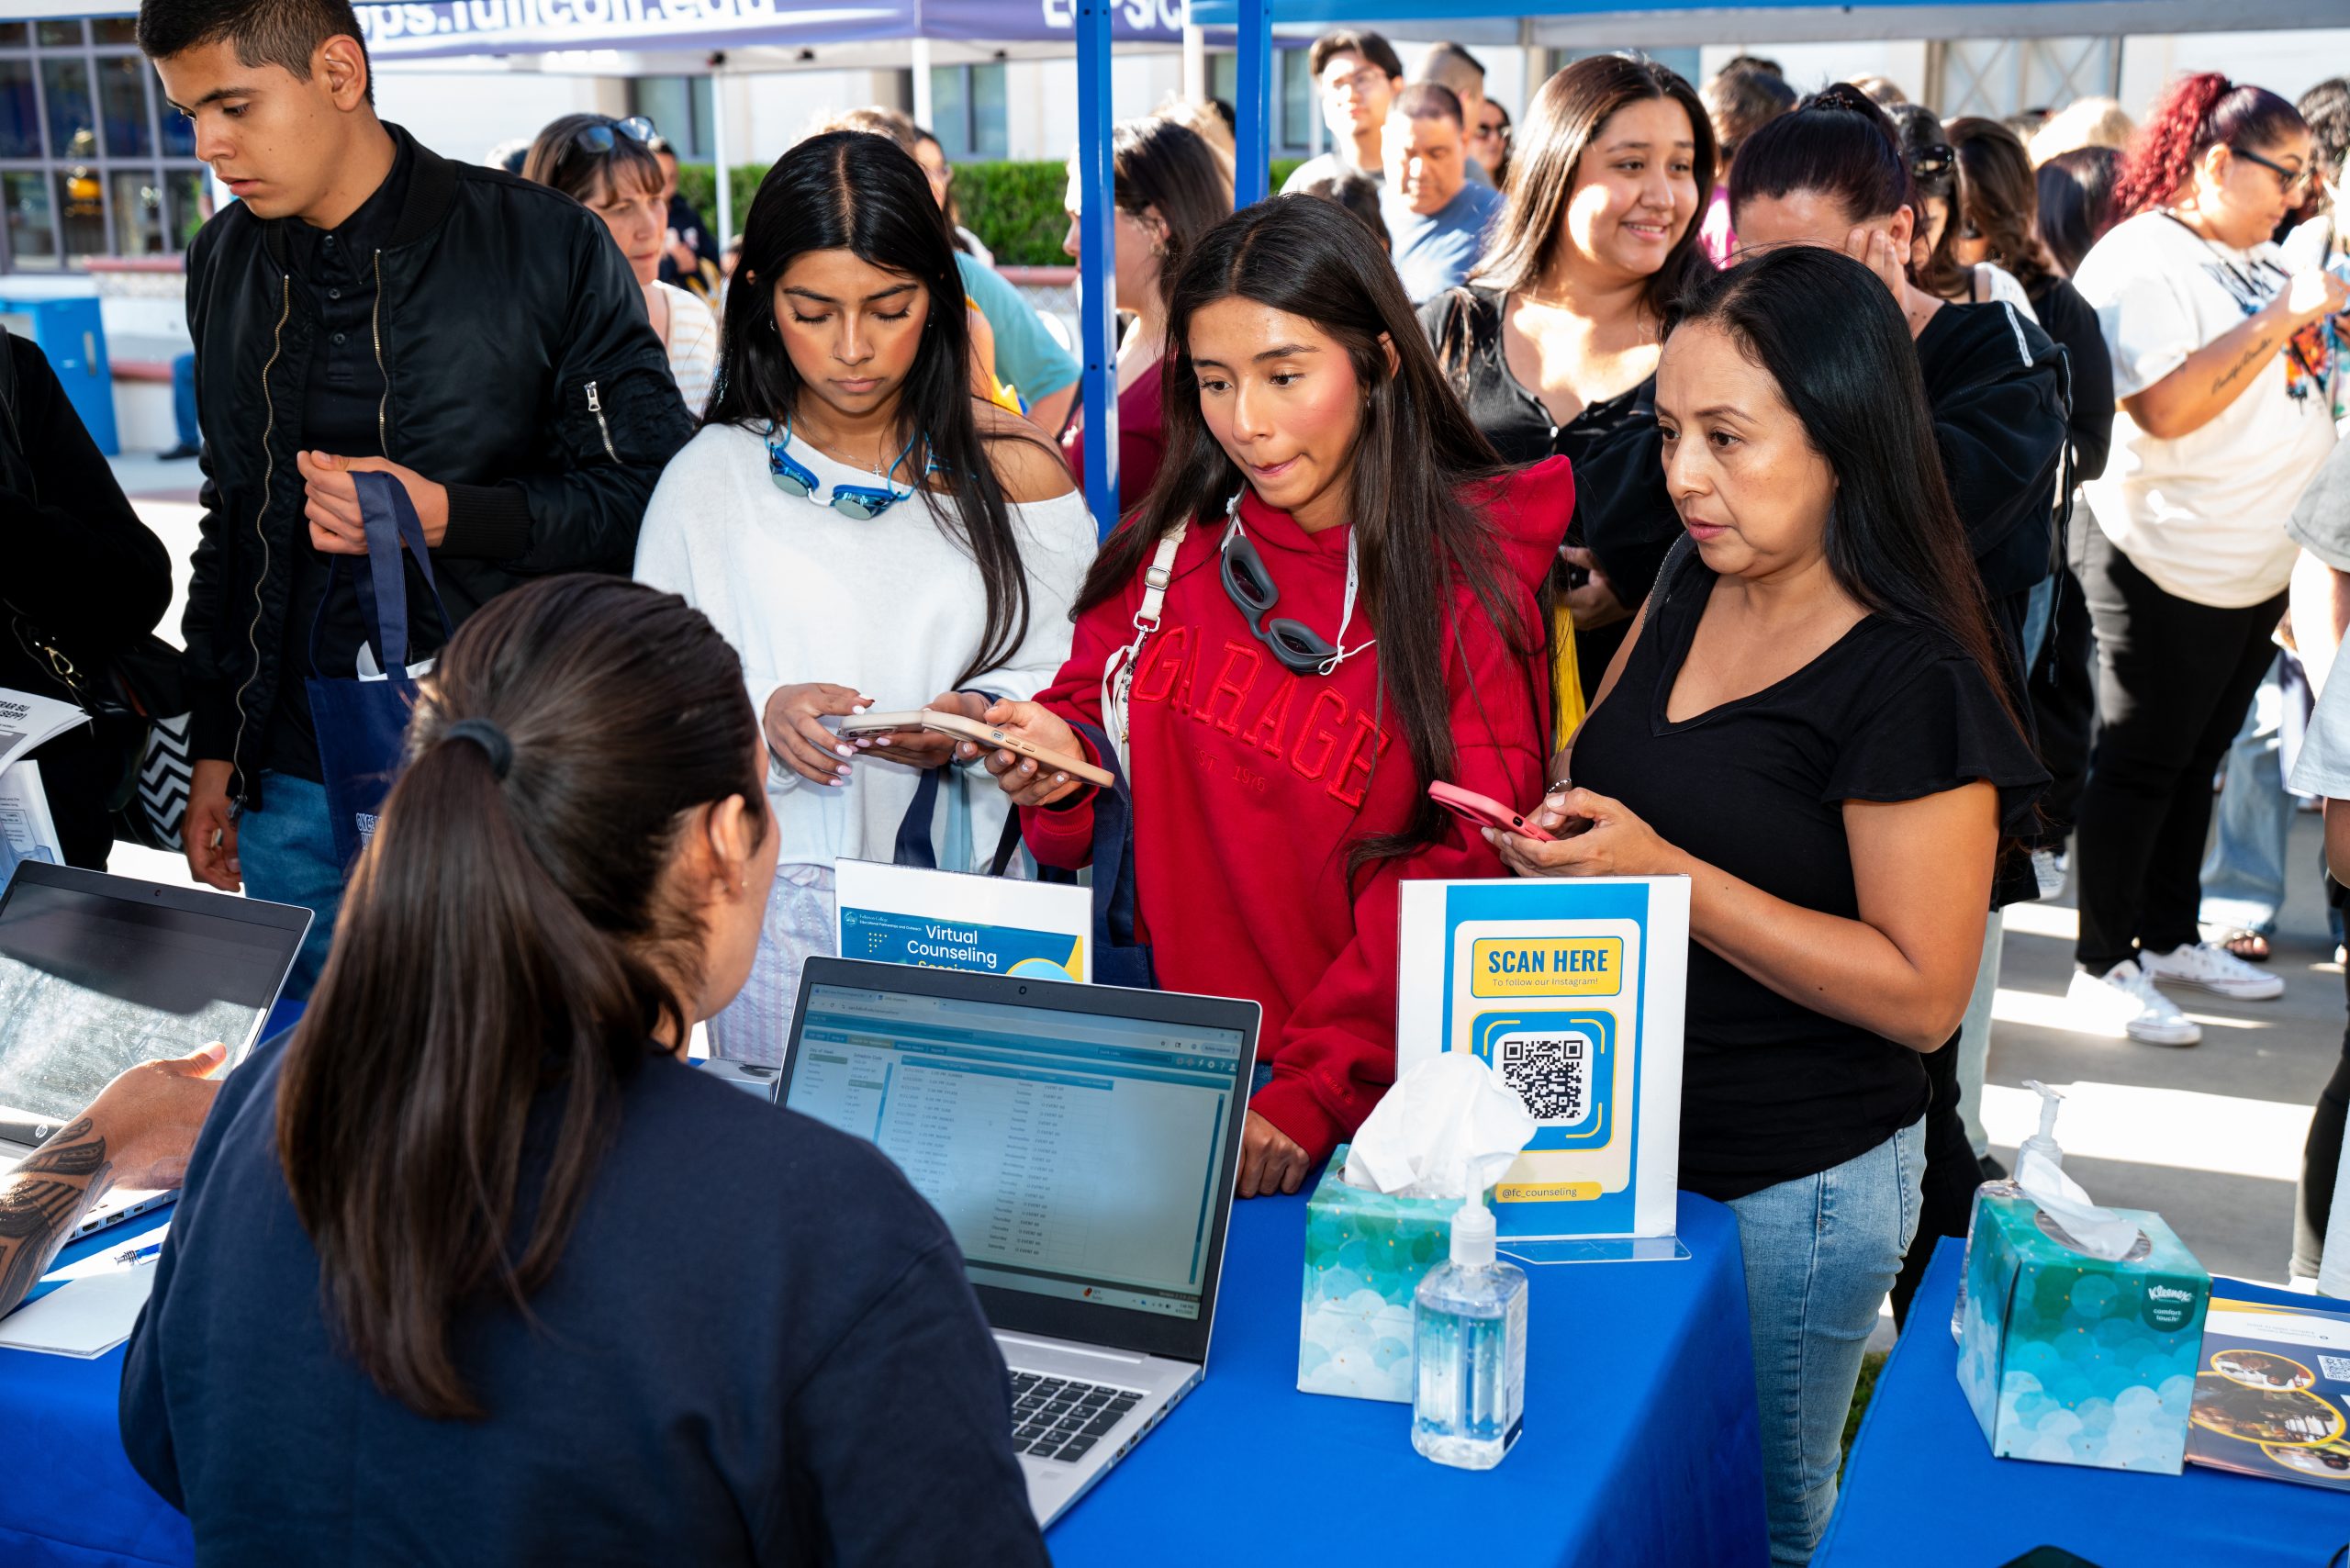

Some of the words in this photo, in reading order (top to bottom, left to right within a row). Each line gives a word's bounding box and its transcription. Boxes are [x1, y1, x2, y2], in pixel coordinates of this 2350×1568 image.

[0, 700, 17, 710] RAR
[1131, 626, 1393, 812] GARAGE
[1231, 765, 1267, 792] 1975
[925, 924, 978, 945] Virtual
[907, 940, 997, 969] Counseling
[1488, 950, 1545, 974] SCAN
[1553, 949, 1609, 972] HERE
[1493, 979, 1503, 987] To
[1551, 978, 1598, 988] Instagram!
[1502, 1188, 1577, 1198] @fc_counseling
[2148, 1285, 2193, 1302] Kleenex
